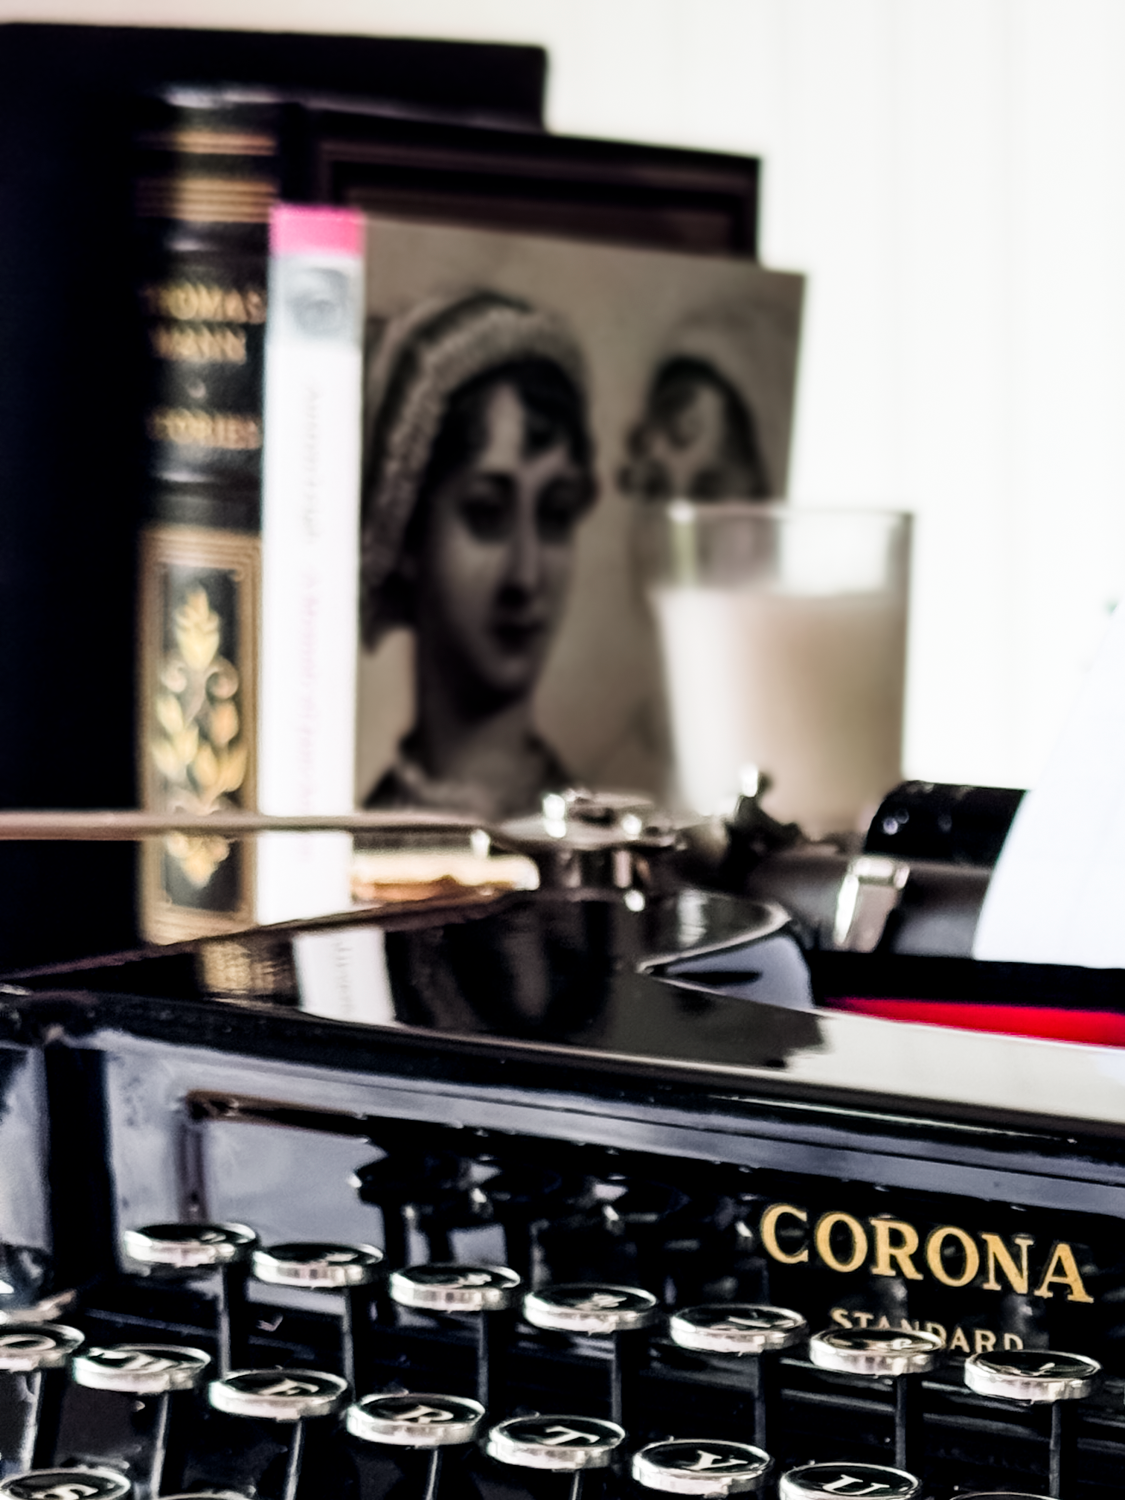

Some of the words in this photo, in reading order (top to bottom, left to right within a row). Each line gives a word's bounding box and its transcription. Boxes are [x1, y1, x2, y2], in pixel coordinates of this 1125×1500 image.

[760, 1203, 1094, 1303] CORONA
[394, 1405, 454, 1424] R
[542, 1425, 601, 1446] T
[683, 1450, 749, 1471] Y
[822, 1474, 891, 1497] U
